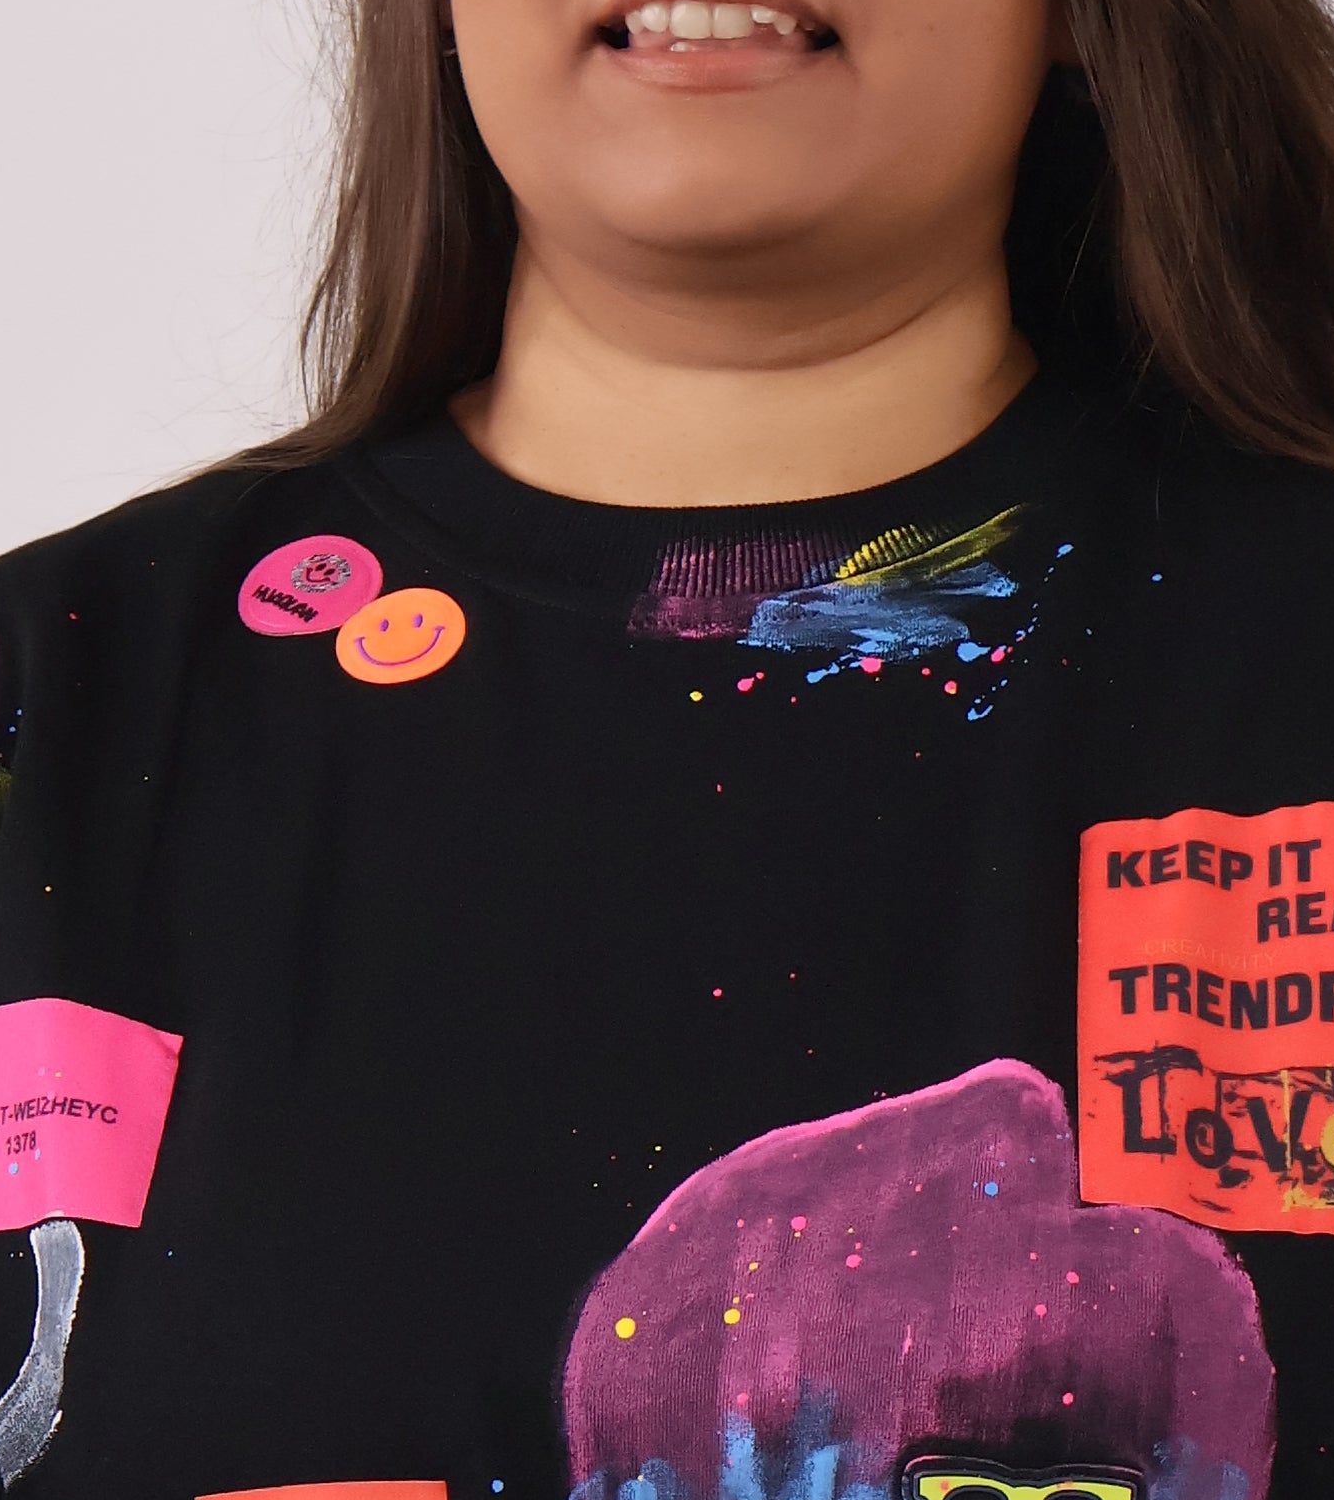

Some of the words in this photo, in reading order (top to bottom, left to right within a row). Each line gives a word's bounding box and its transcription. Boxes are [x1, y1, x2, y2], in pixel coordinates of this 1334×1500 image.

[1106, 840, 1253, 891] KEEP
[1268, 839, 1322, 886] IT
[5, 1131, 37, 1156] 1378
